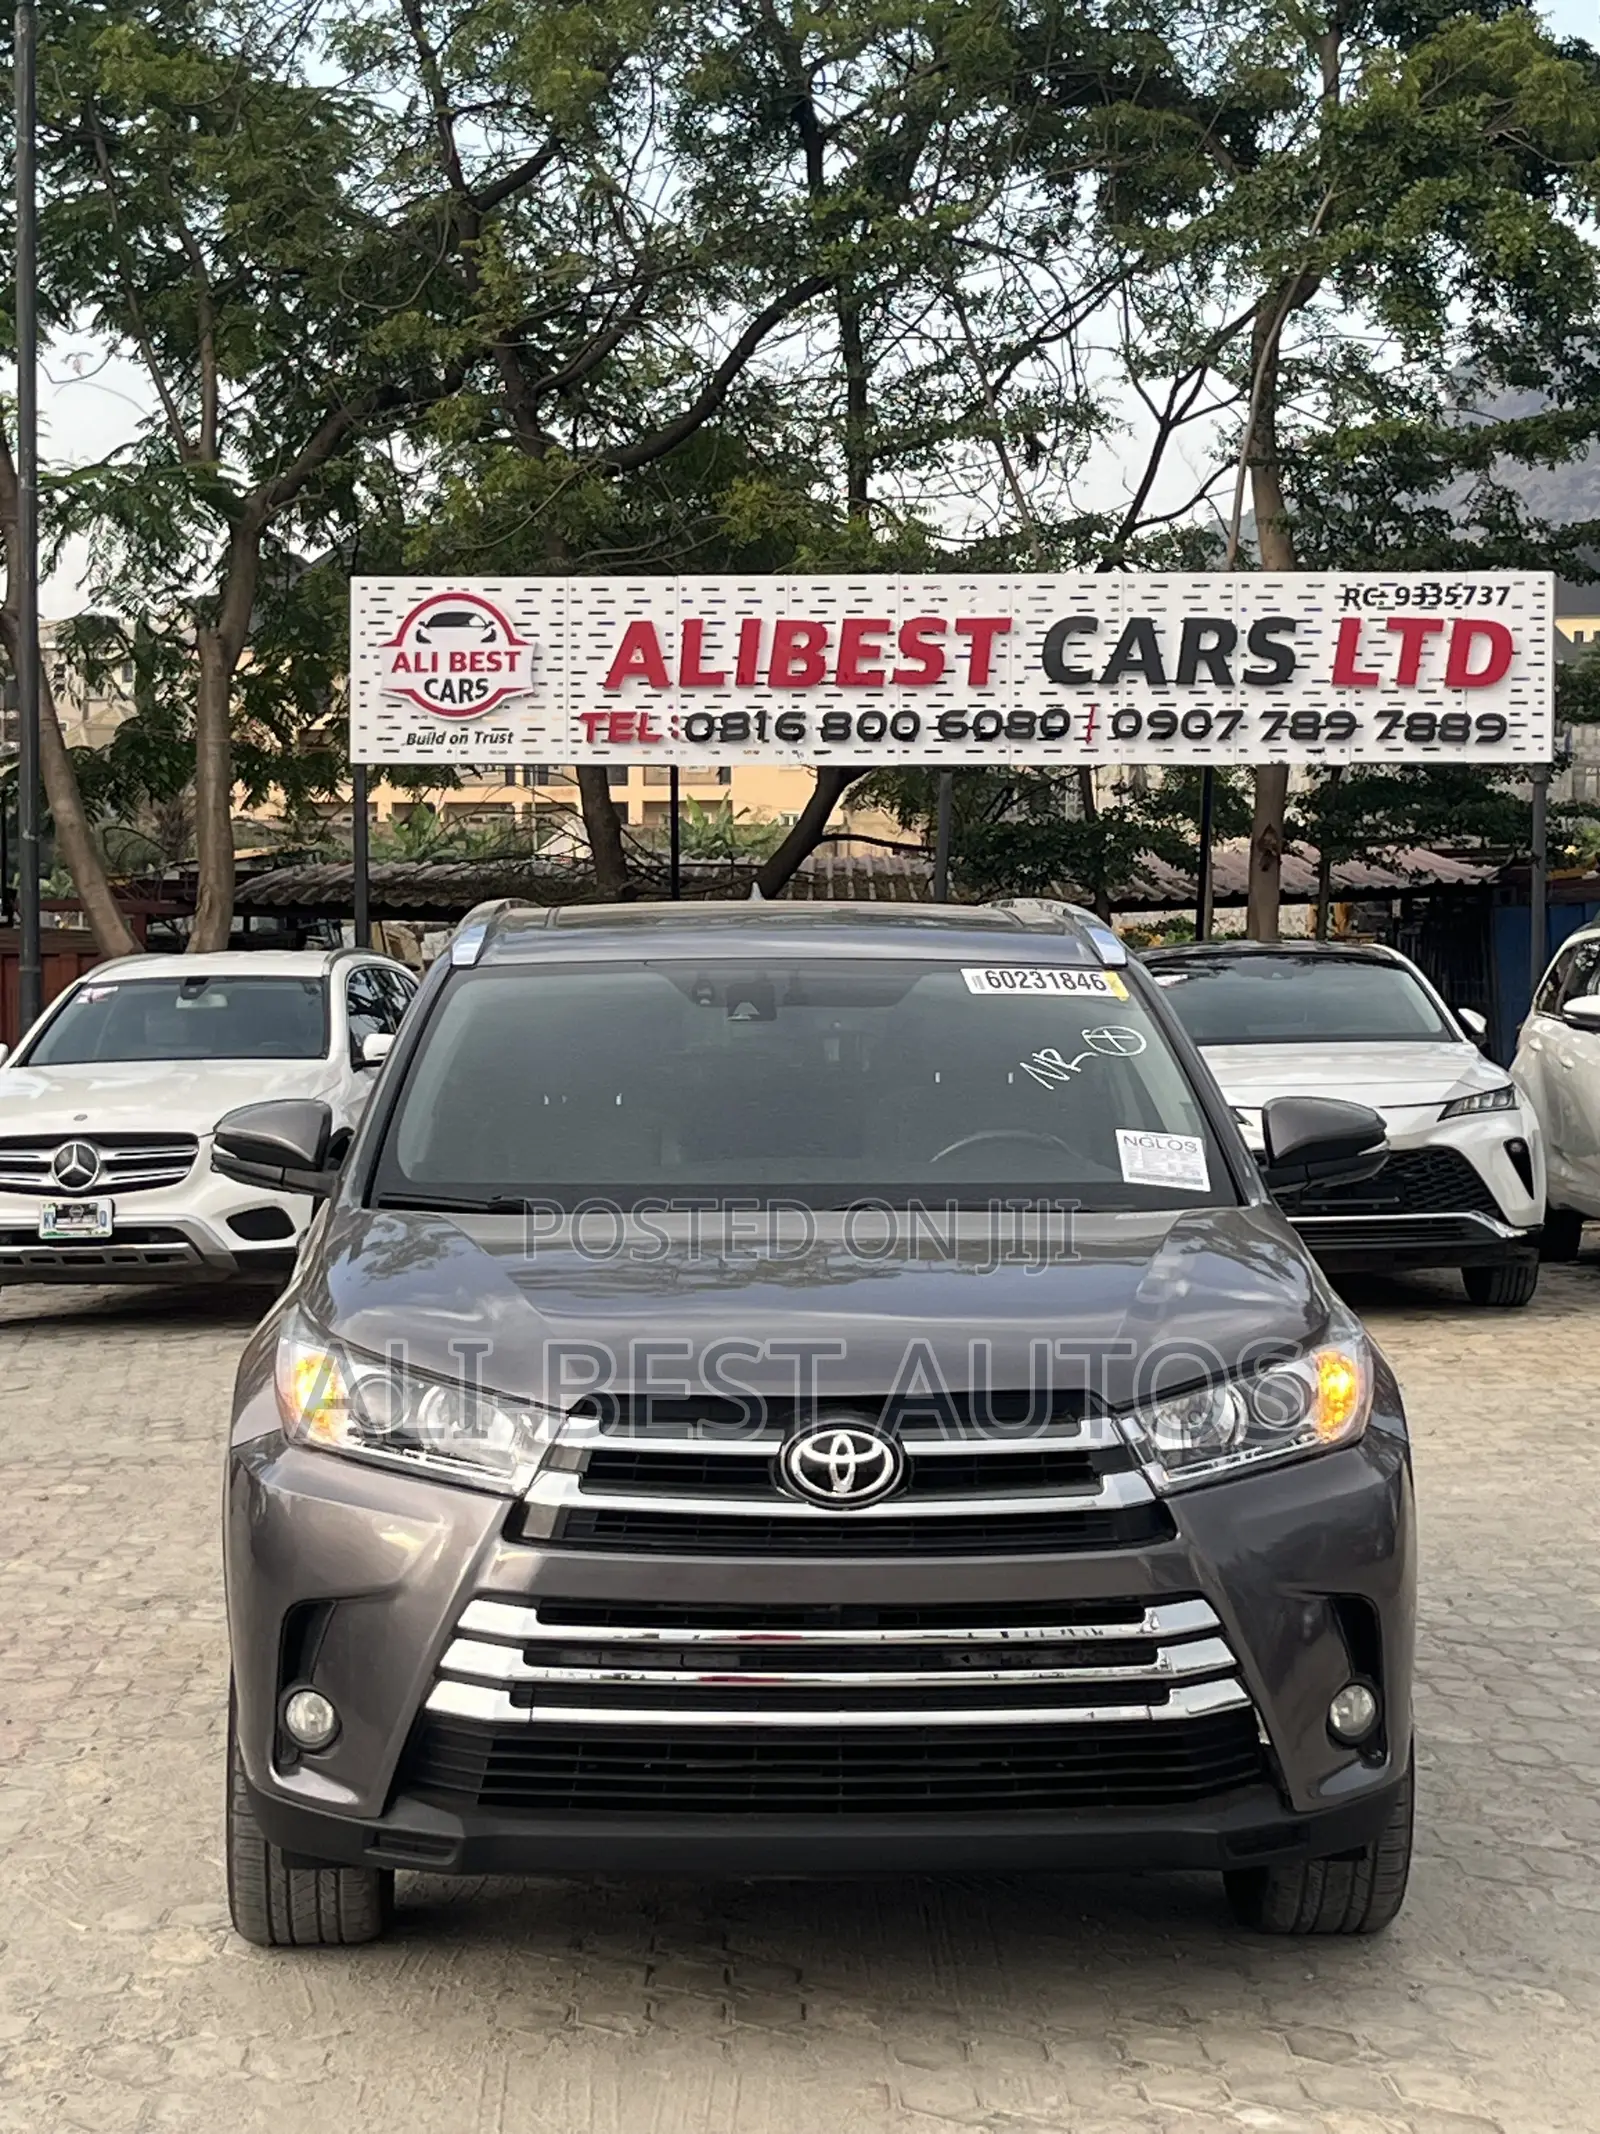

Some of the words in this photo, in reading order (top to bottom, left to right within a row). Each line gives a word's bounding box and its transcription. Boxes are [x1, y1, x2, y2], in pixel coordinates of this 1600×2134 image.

[1394, 585, 1511, 607] 9335737
[391, 651, 439, 674] ALI
[449, 651, 522, 673] BEST
[603, 616, 1012, 690] ALIBEST
[1041, 615, 1298, 687] CARS
[1331, 616, 1513, 689] LTD
[424, 678, 489, 704] CARS
[820, 709, 921, 743] 800
[936, 708, 1071, 742] 6080
[1111, 709, 1245, 742] 0907
[1261, 710, 1358, 743] 789
[1376, 710, 1508, 744] 7889
[406, 731, 446, 746] Build
[450, 733, 468, 745] on
[474, 731, 514, 745] Trust
[984, 970, 1107, 991] 60231846
[1123, 1135, 1198, 1154] NGLOS
